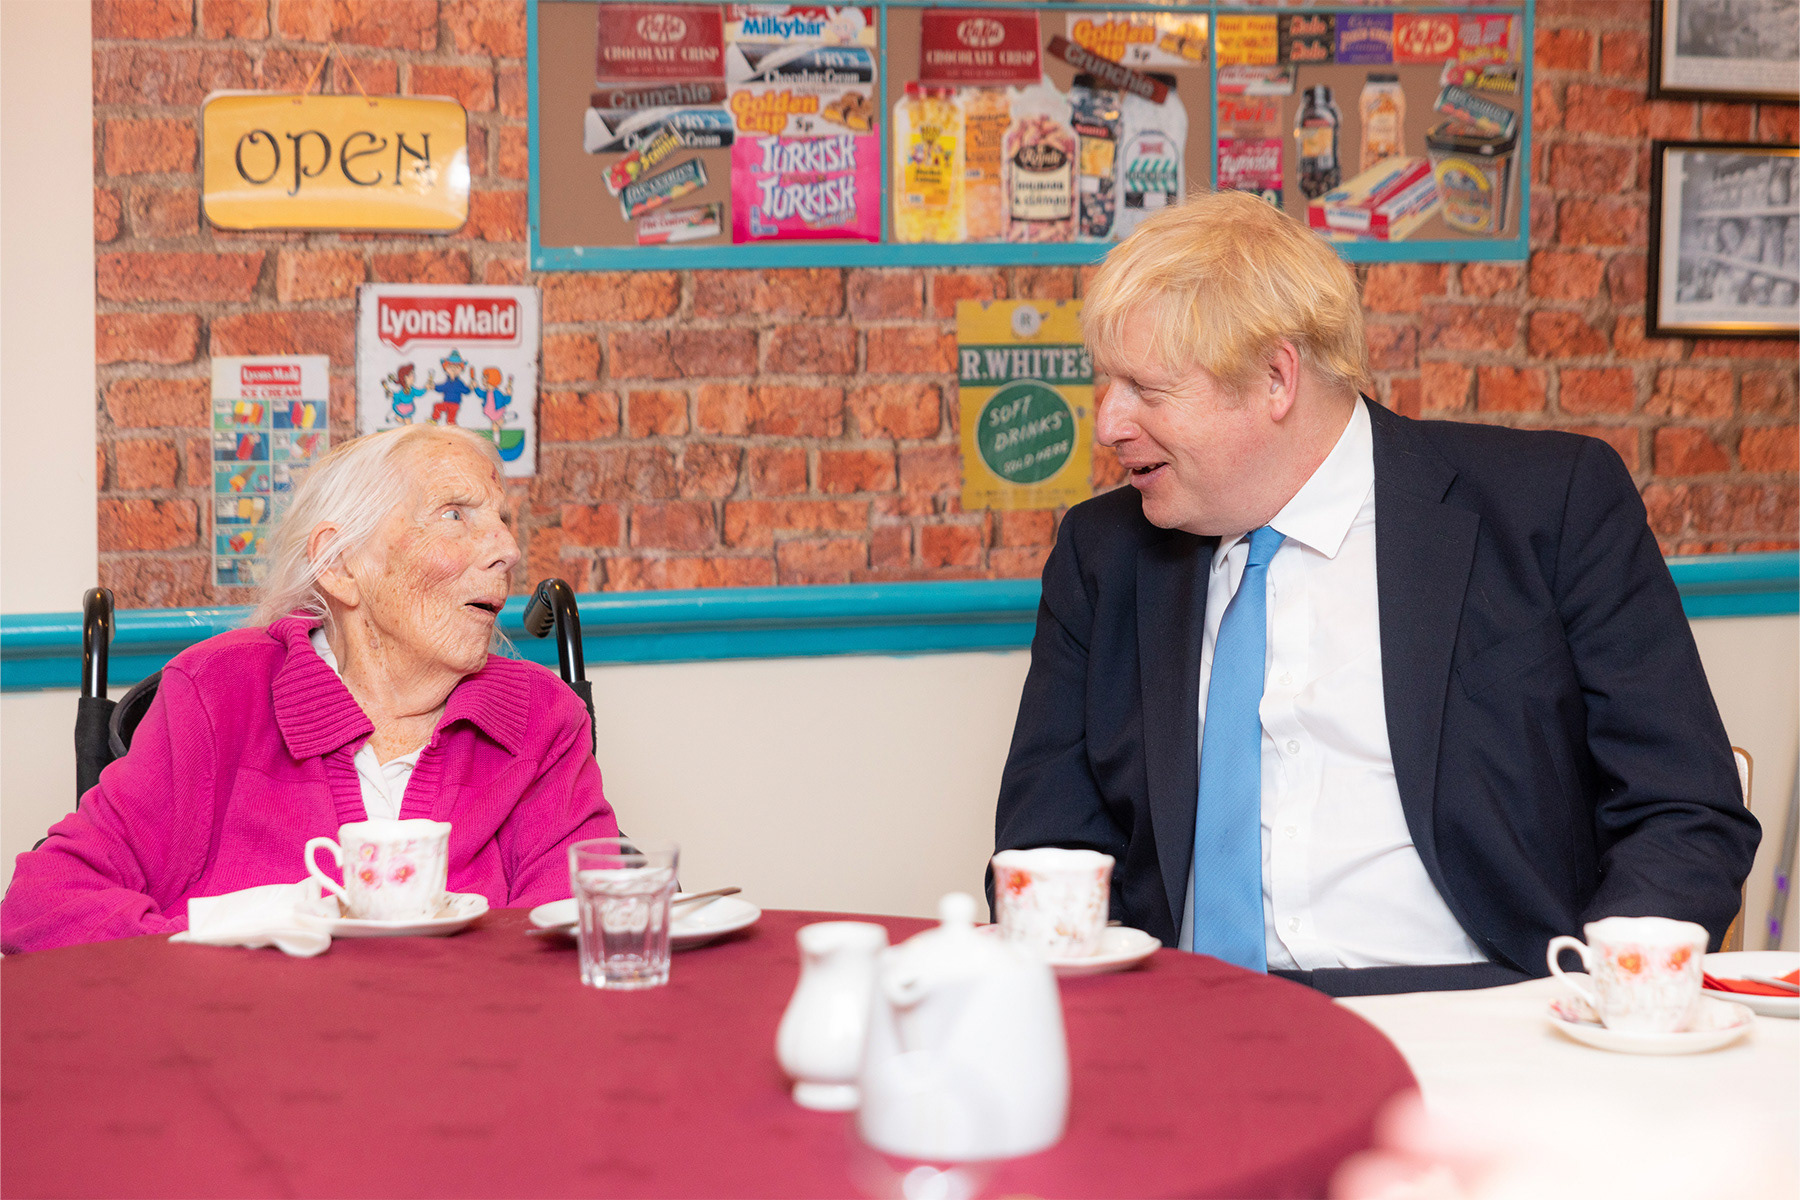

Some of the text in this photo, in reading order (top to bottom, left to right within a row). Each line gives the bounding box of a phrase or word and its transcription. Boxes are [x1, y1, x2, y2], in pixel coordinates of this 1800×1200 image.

[743, 17, 825, 38] Milkybar
[1073, 19, 1156, 46] Golden
[604, 46, 719, 61] CHOCOLATE CRISP
[814, 52, 861, 67] FRY'S
[926, 50, 1036, 66] CHOCOLATE CRISP
[763, 69, 860, 83] Chocolate Cream
[1065, 44, 1154, 97] Crunchie
[610, 83, 712, 109] Crunchie
[731, 90, 820, 114] Golden
[673, 113, 721, 130] FRY'S
[1218, 101, 1277, 122] Twix
[737, 112, 788, 134] Cup
[756, 133, 857, 173] TURKISH
[756, 174, 857, 221] TURKISH
[381, 303, 516, 339] Lyons Maid
[242, 364, 300, 383] Lyons Maid
[261, 389, 302, 398] CREAM
[988, 394, 1033, 427] SOFT
[994, 410, 1063, 452] DRINKS
